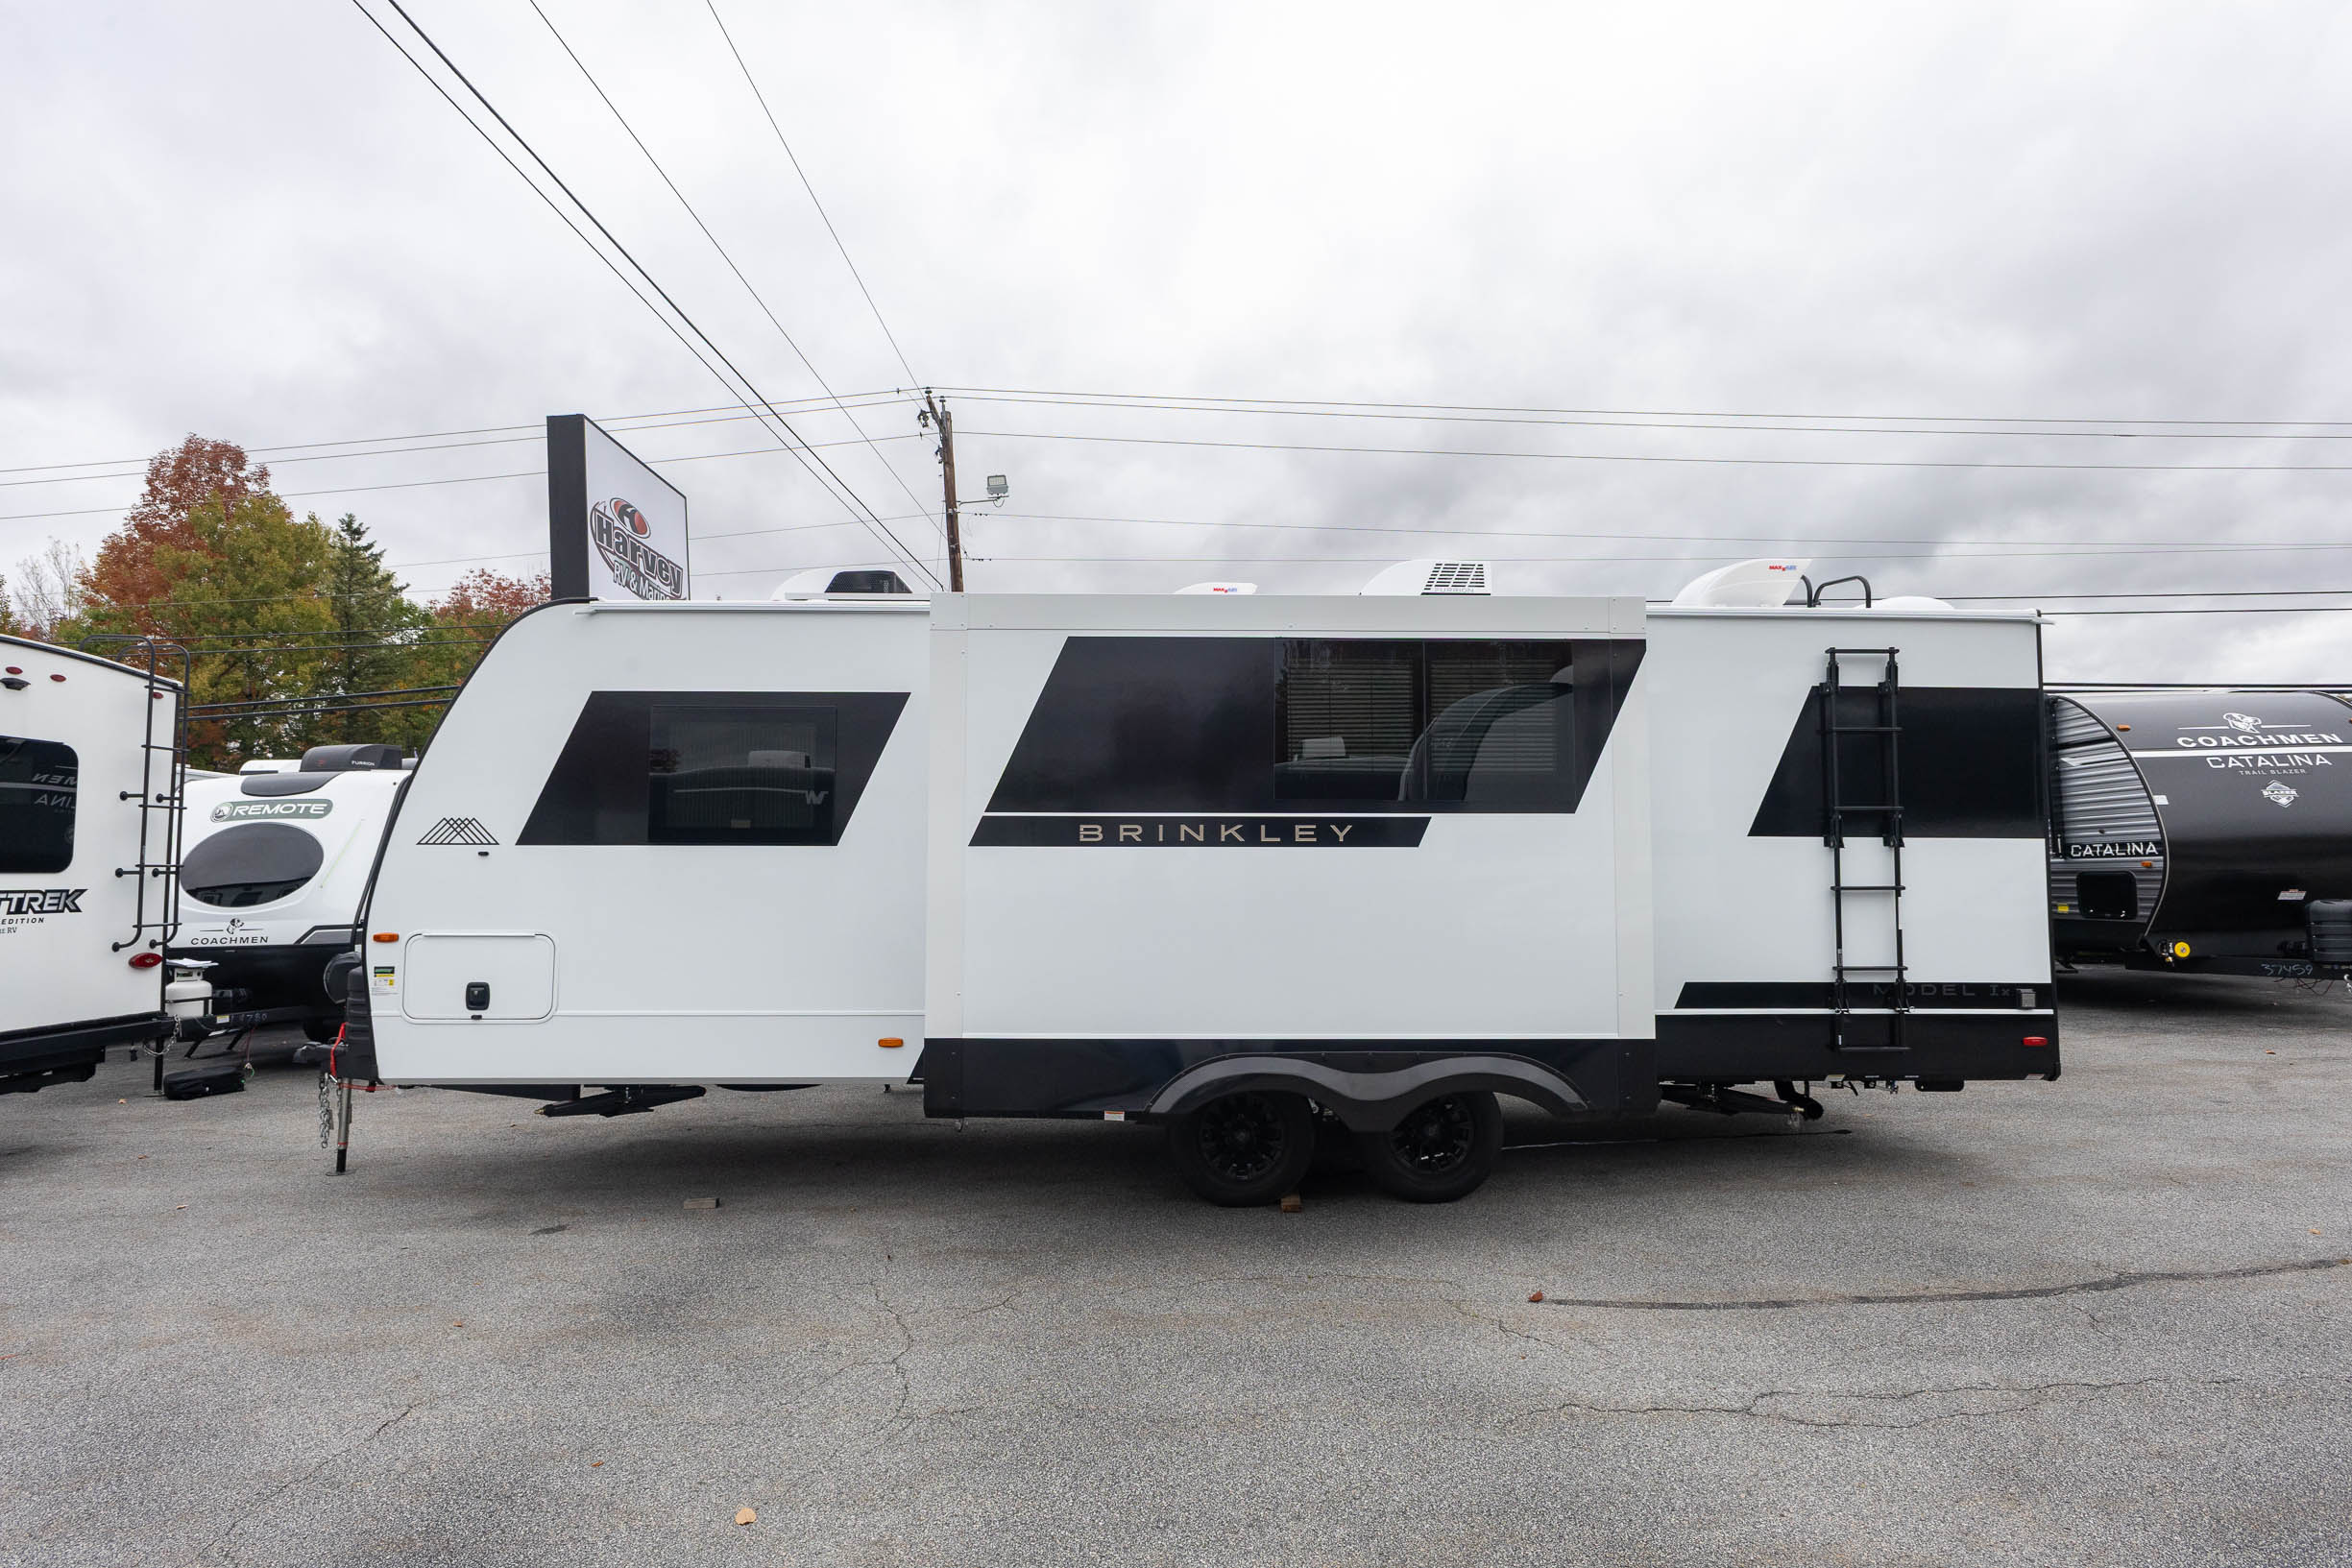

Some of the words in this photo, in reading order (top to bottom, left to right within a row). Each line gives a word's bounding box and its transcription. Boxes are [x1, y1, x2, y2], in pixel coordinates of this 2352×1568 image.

[594, 510, 683, 598] Harvey
[614, 560, 628, 587] RV
[629, 571, 638, 591] &
[2176, 734, 2343, 748] COACHMEN
[2206, 754, 2332, 768] CATALINA
[232, 804, 327, 816] REMOTE
[1079, 824, 1353, 842] BRINKLEY
[2071, 842, 2159, 857] CATALINA
[190, 936, 269, 946] COACHMEN
